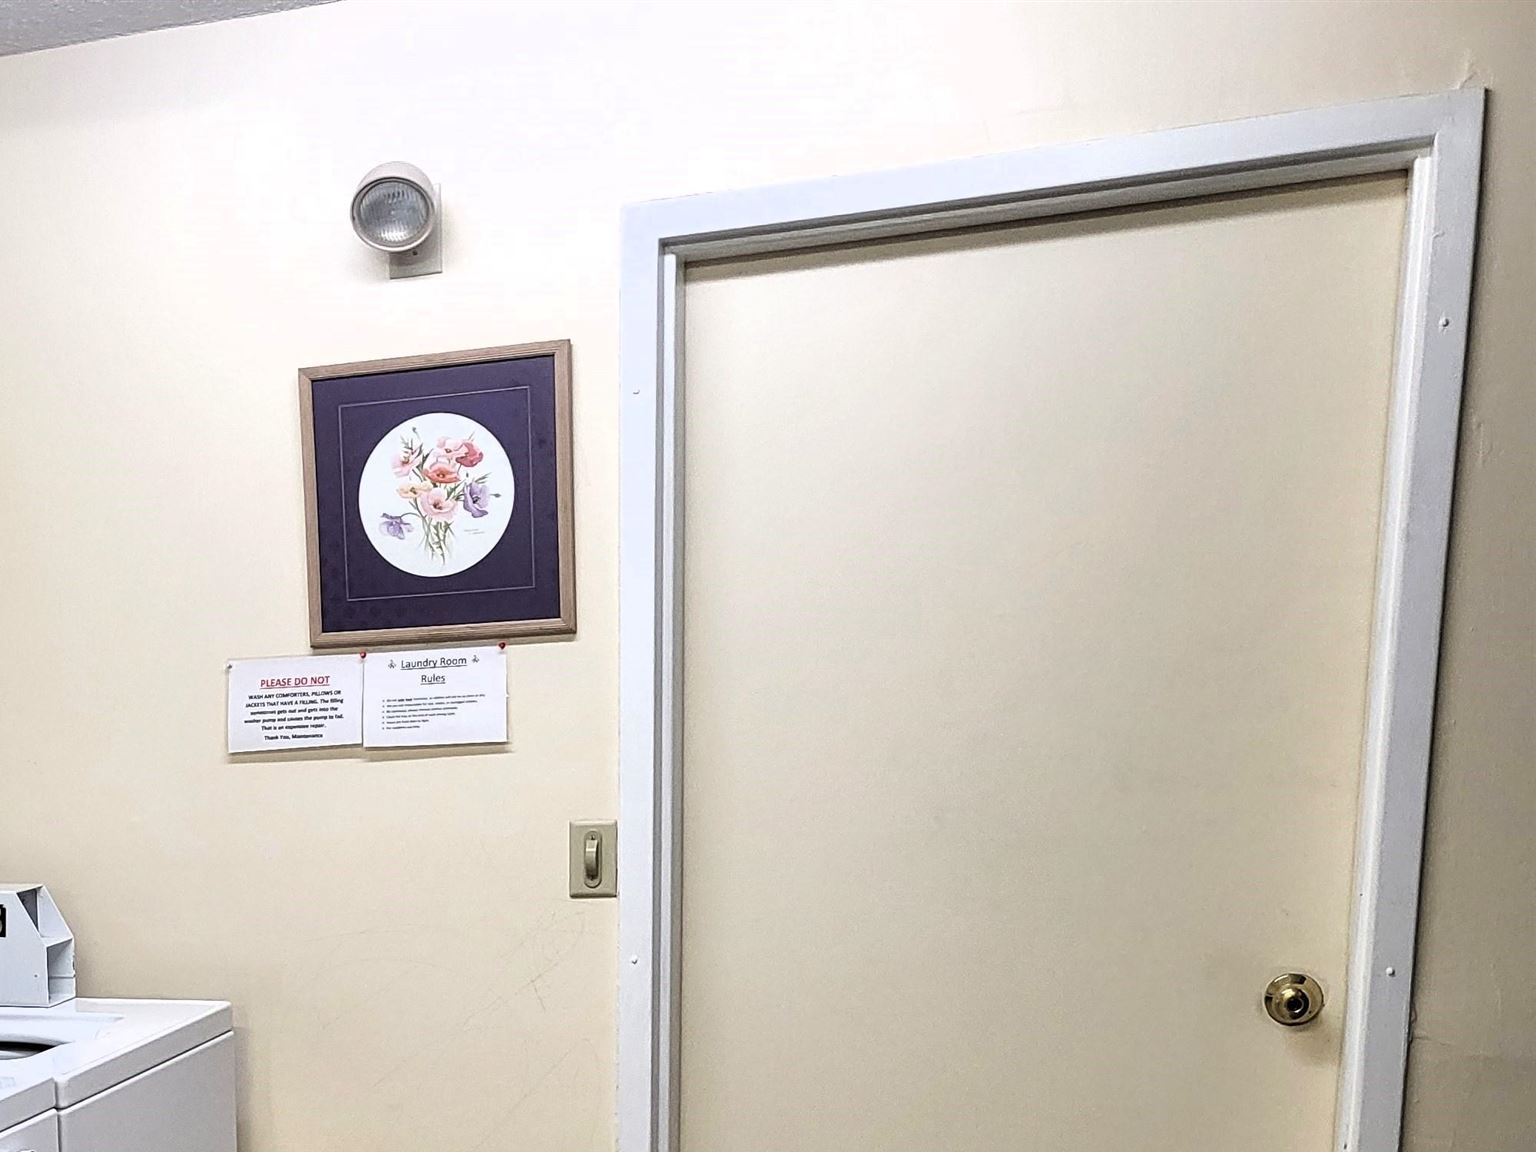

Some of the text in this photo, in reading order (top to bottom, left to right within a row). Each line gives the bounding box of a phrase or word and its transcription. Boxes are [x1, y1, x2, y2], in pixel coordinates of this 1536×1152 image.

[400, 657, 467, 668] Laundry Room
[260, 676, 330, 688] PLEASE DO NOT
[421, 674, 446, 683] Rules
